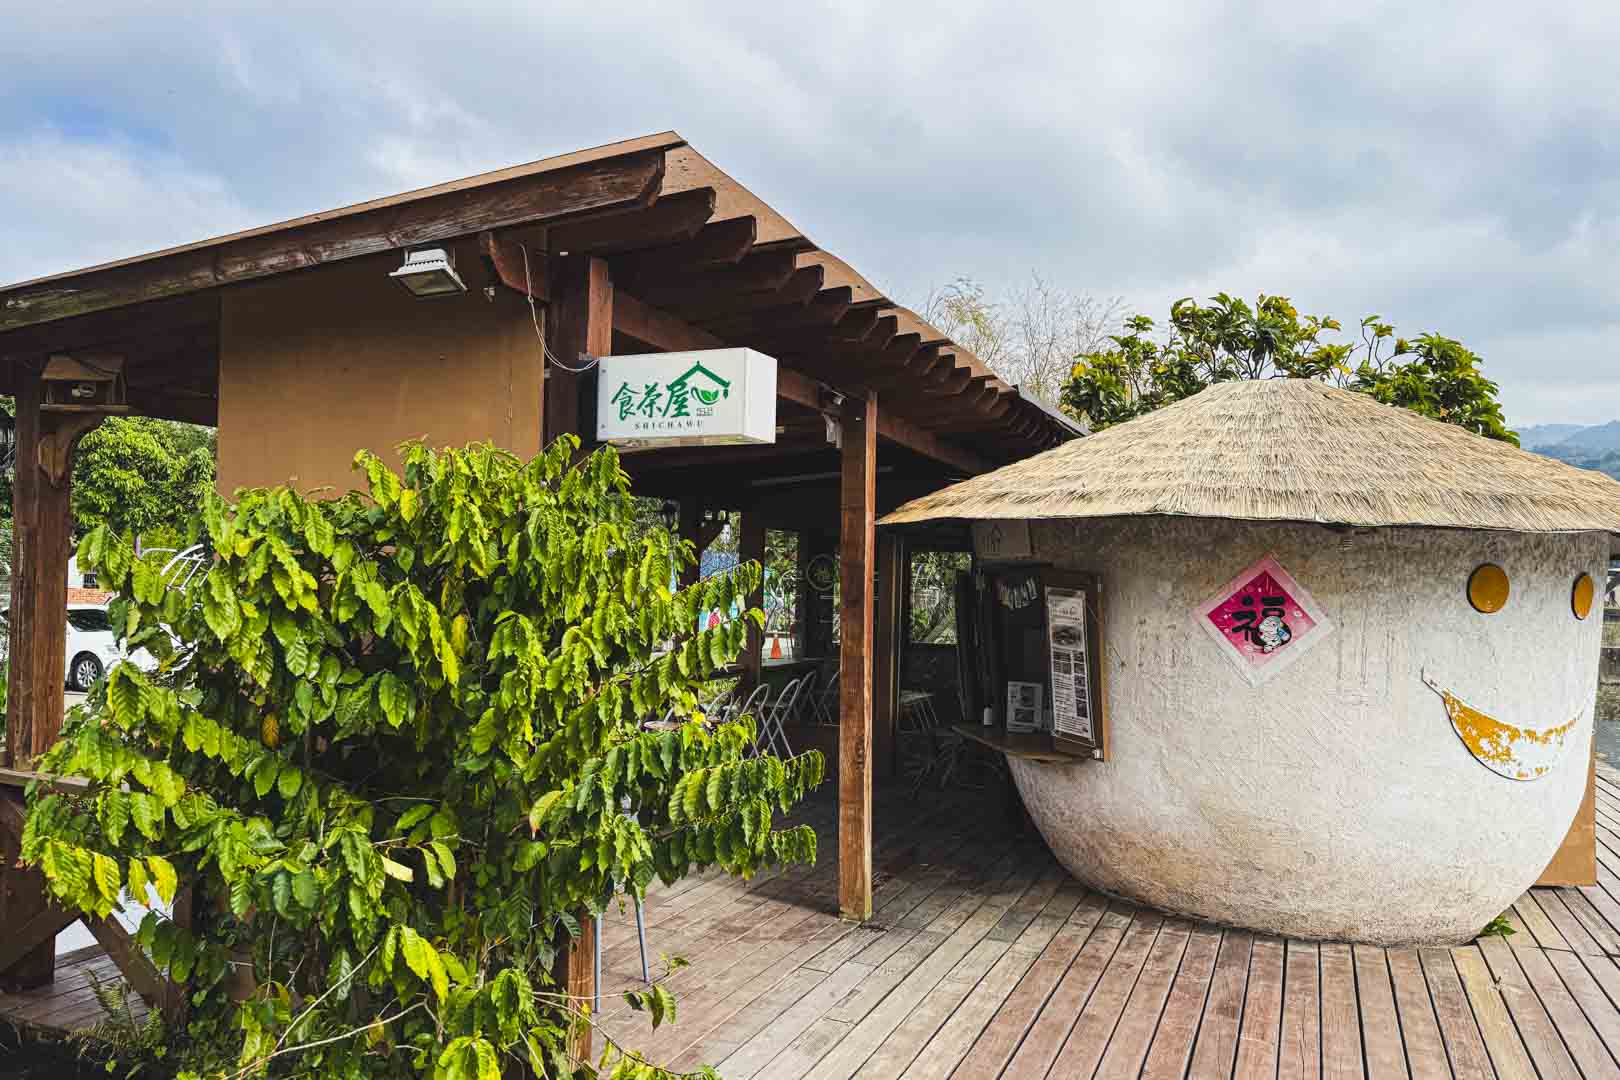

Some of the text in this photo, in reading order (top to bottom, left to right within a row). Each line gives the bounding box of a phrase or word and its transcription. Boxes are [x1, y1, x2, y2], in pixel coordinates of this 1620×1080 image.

[611, 380, 691, 421] 食茶屋
[635, 419, 703, 431] SHICHAWU
